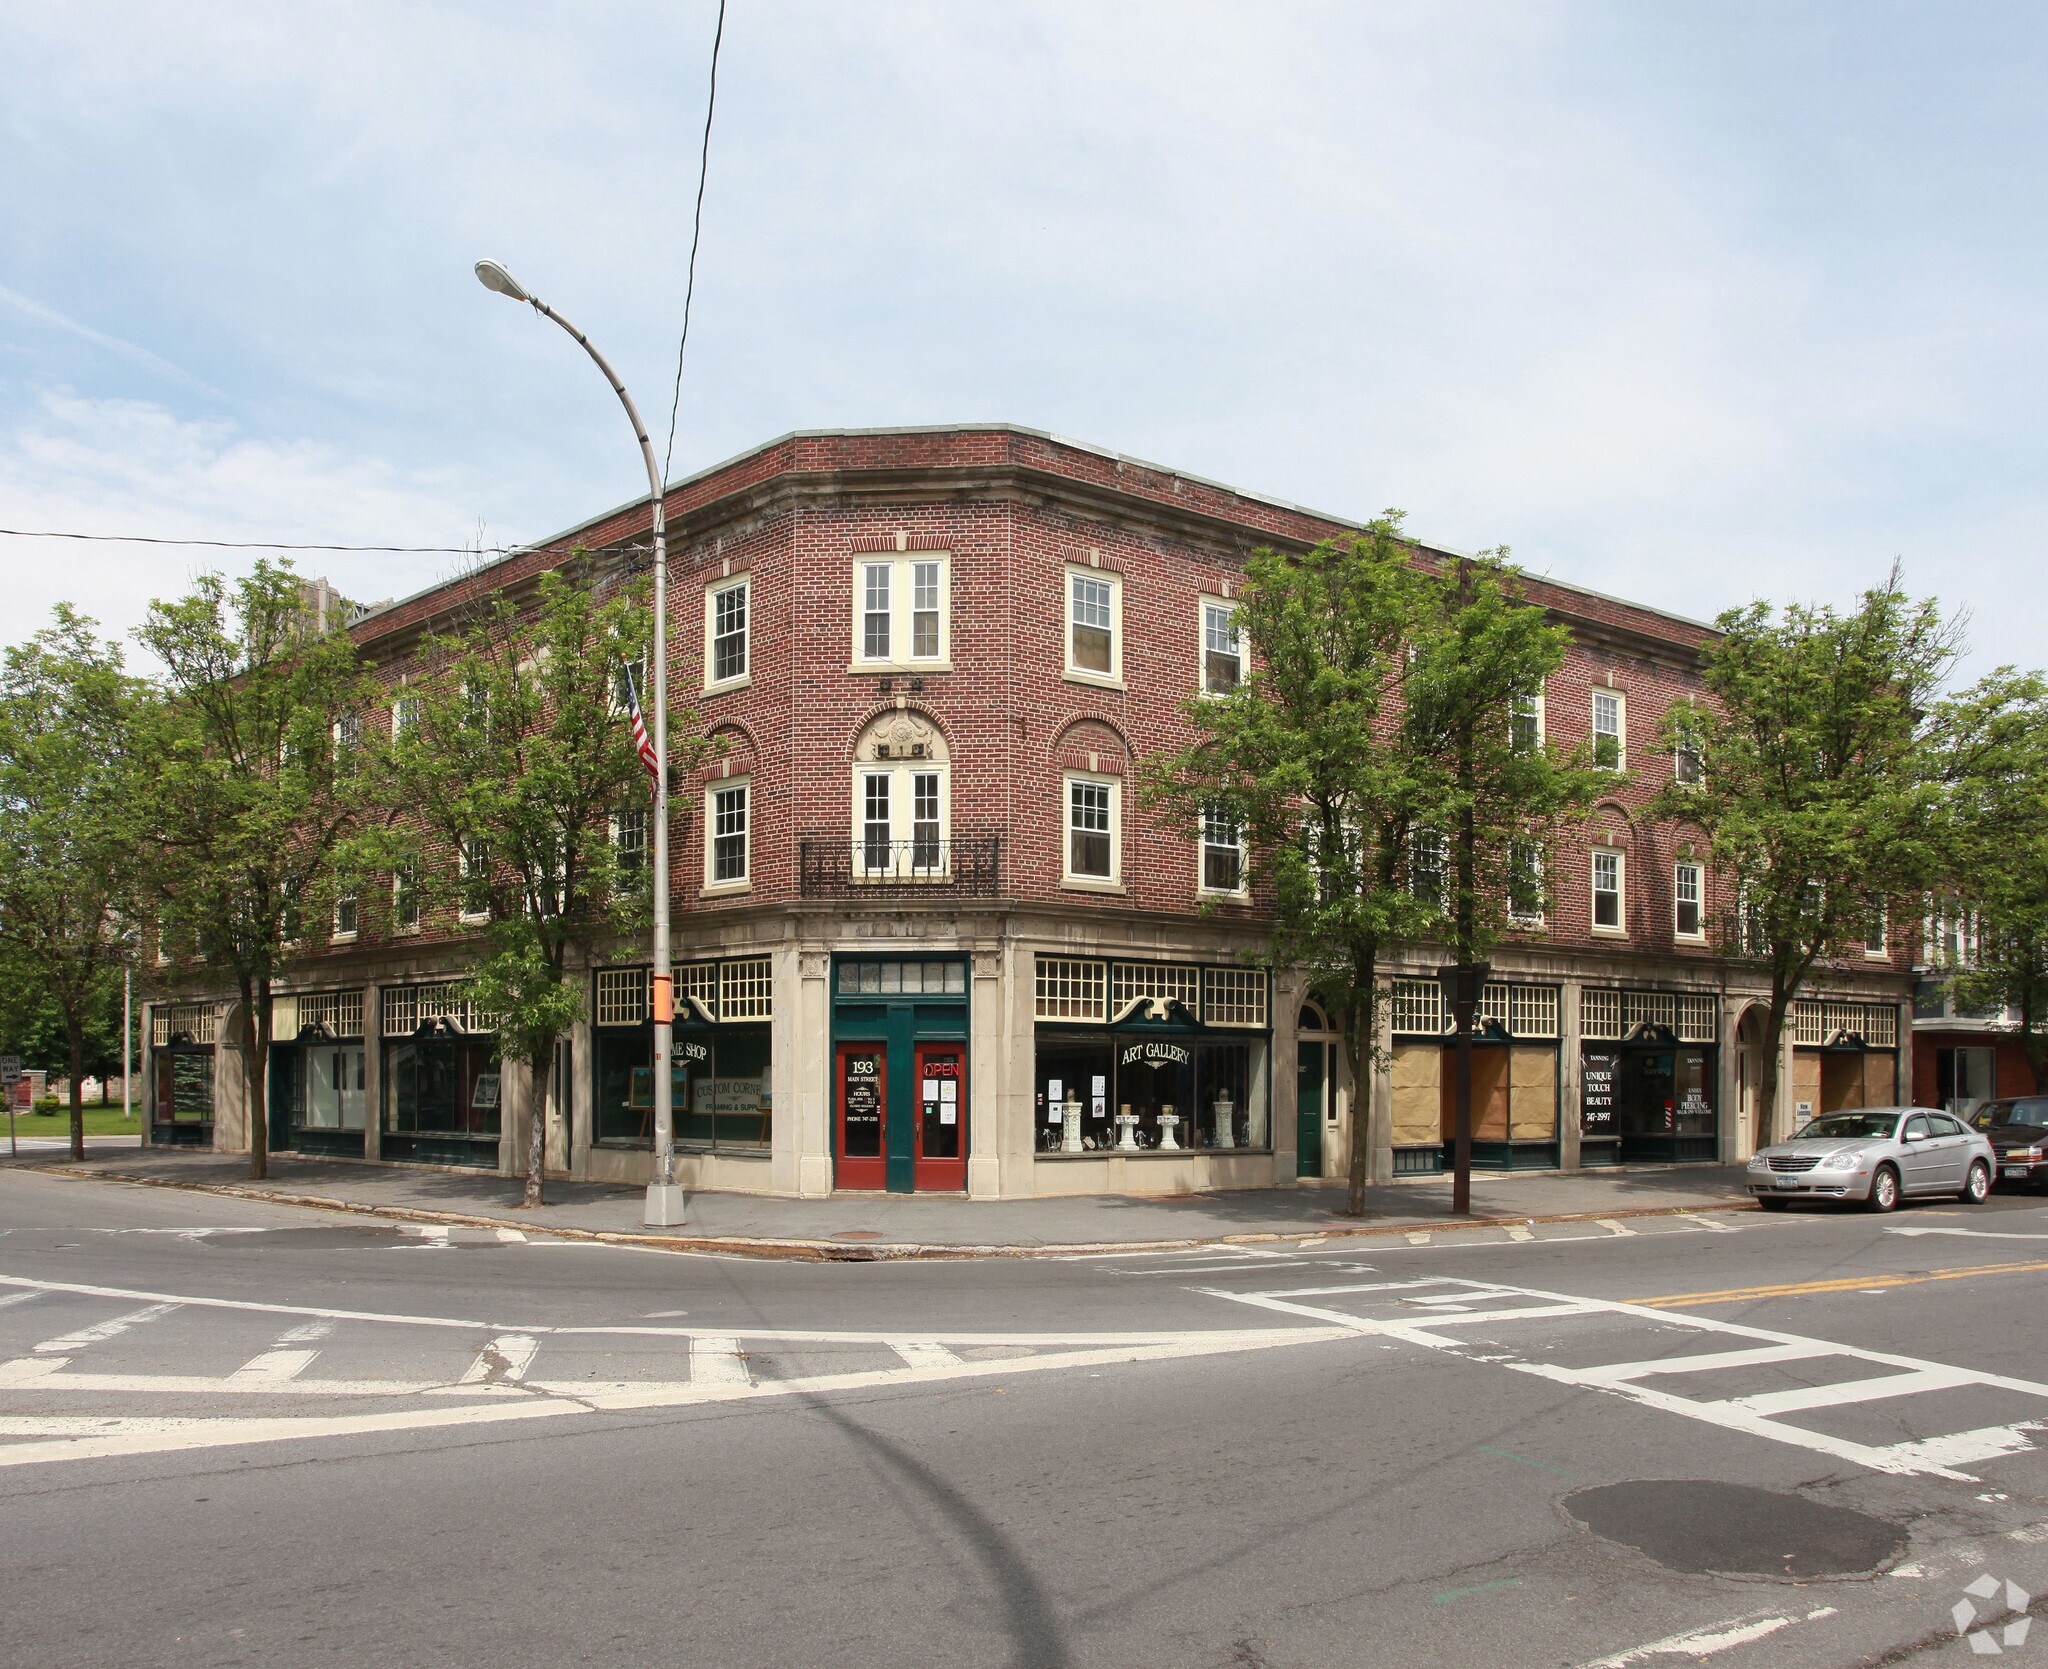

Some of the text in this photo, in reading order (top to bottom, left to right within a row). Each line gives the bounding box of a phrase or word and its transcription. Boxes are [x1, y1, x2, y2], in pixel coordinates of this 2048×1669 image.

[686, 1042, 706, 1060] SHOP
[1121, 1043, 1189, 1065] ART GALLERY
[852, 1061, 874, 1074] 193
[924, 1063, 959, 1076] OPEN
[1586, 1071, 1612, 1081] UNIQUE
[733, 1081, 760, 1095] CORNE
[1587, 1083, 1611, 1092] TOUCH
[1586, 1097, 1612, 1105] BEAUTY
[1681, 1101, 1708, 1110] PIERCING
